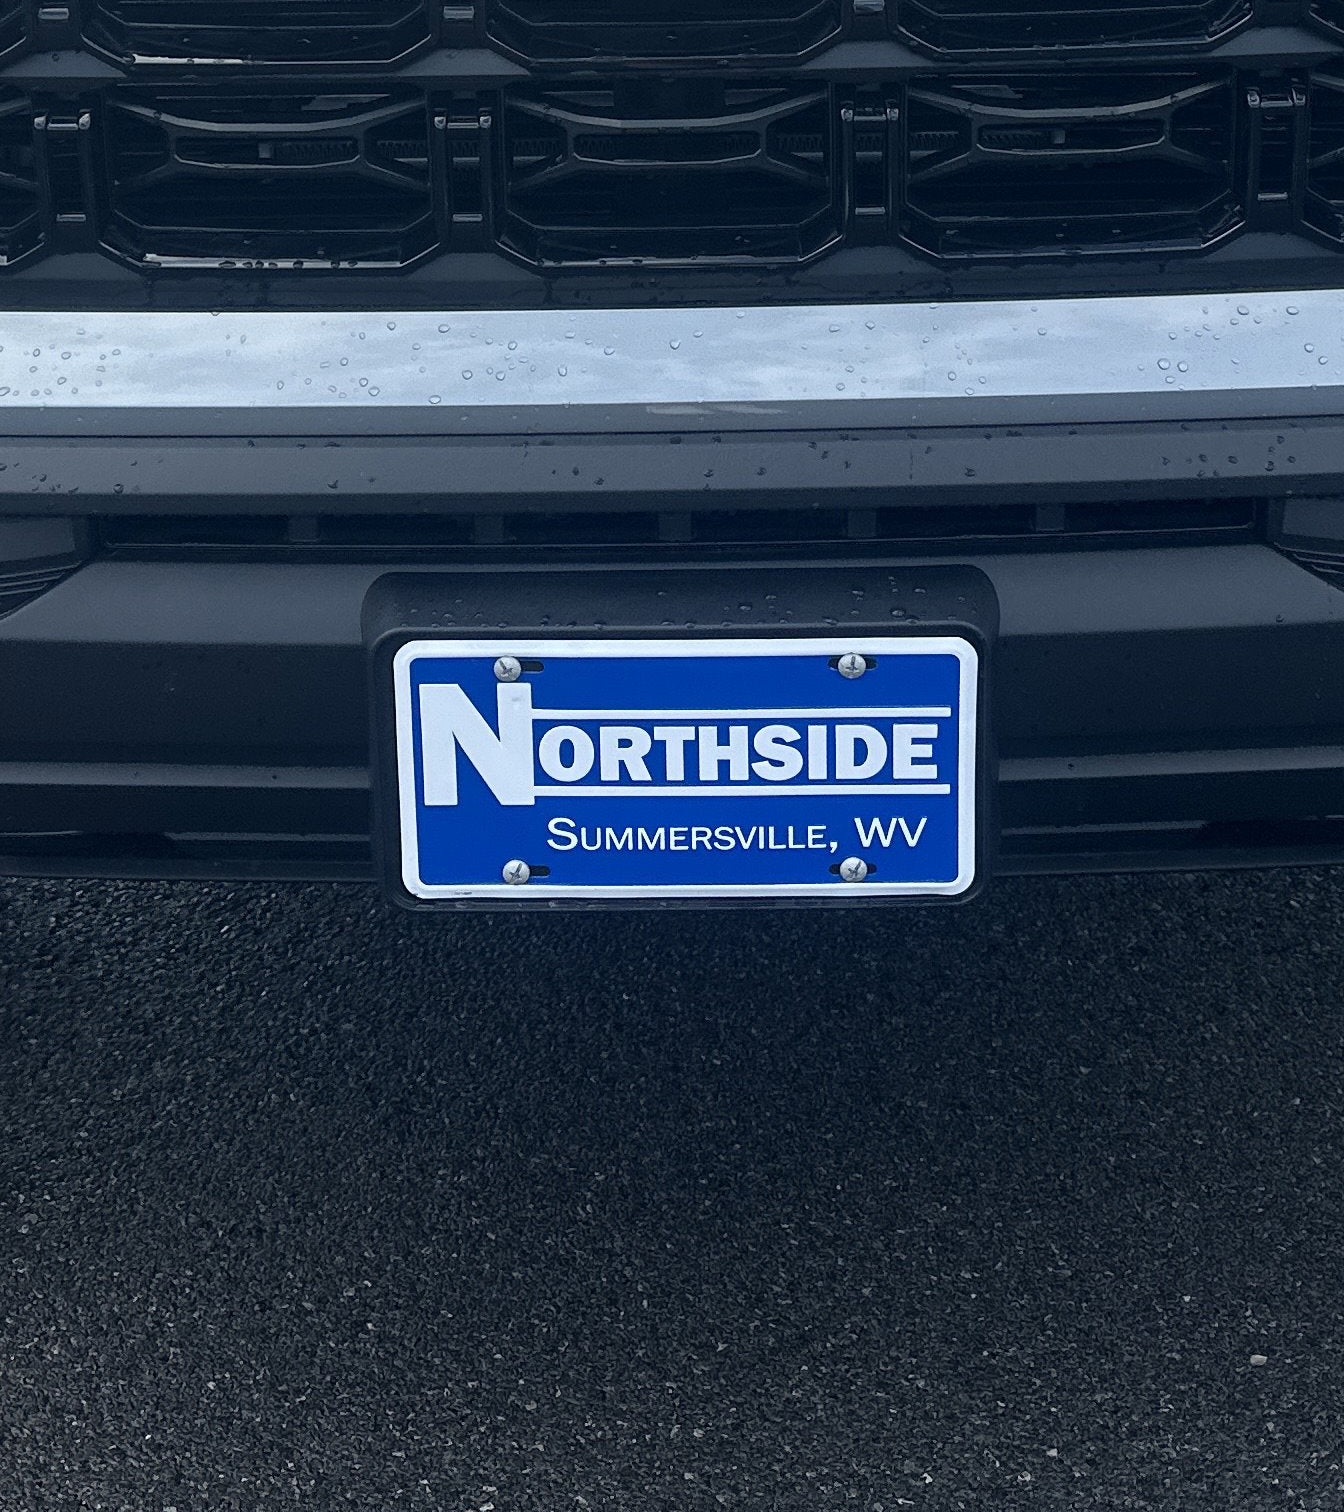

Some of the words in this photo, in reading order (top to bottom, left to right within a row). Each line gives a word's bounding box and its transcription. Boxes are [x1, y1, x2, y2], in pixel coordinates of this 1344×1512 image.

[418, 682, 940, 806] NORTHSIDE
[546, 817, 839, 855] SUMMERSVILLE,
[854, 816, 928, 848] WV
